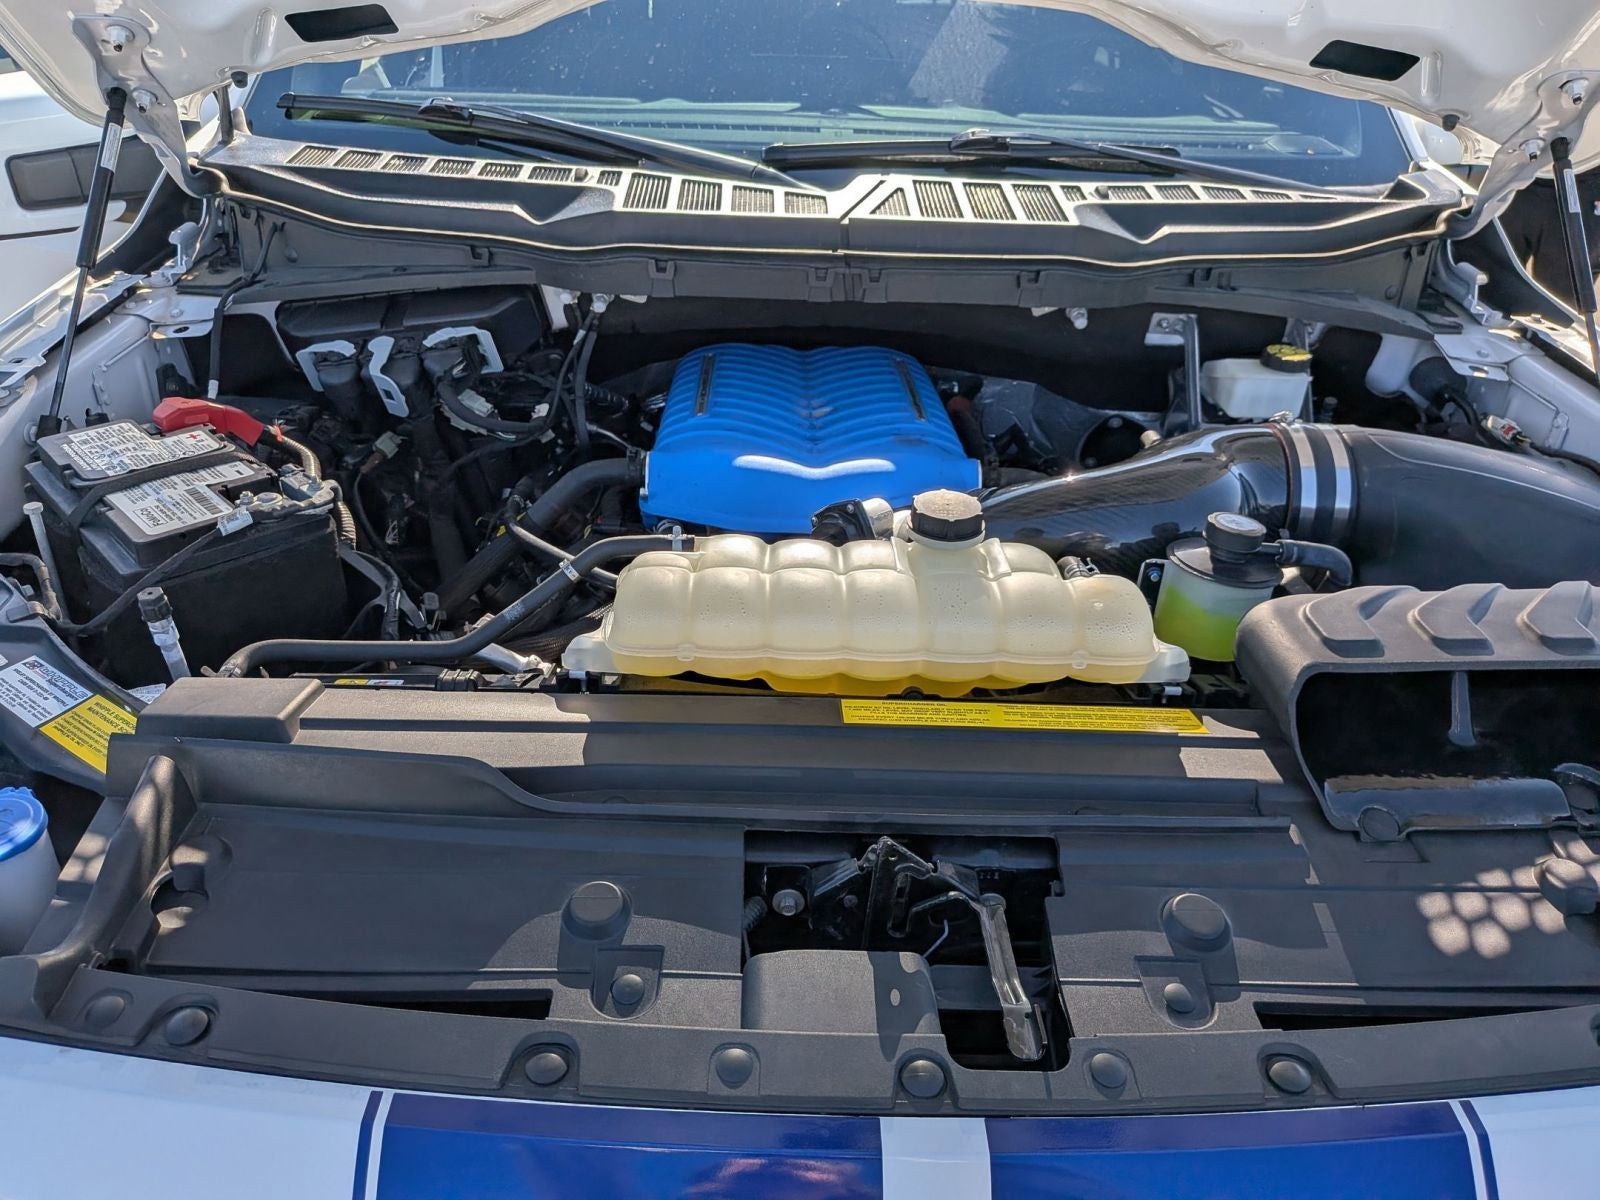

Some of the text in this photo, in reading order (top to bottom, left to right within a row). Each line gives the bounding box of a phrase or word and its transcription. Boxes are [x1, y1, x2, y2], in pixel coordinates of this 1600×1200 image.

[39, 665, 88, 699] WHIPPLE
[86, 706, 120, 728] MAINTENANCE
[93, 701, 116, 715] WHIPPLE
